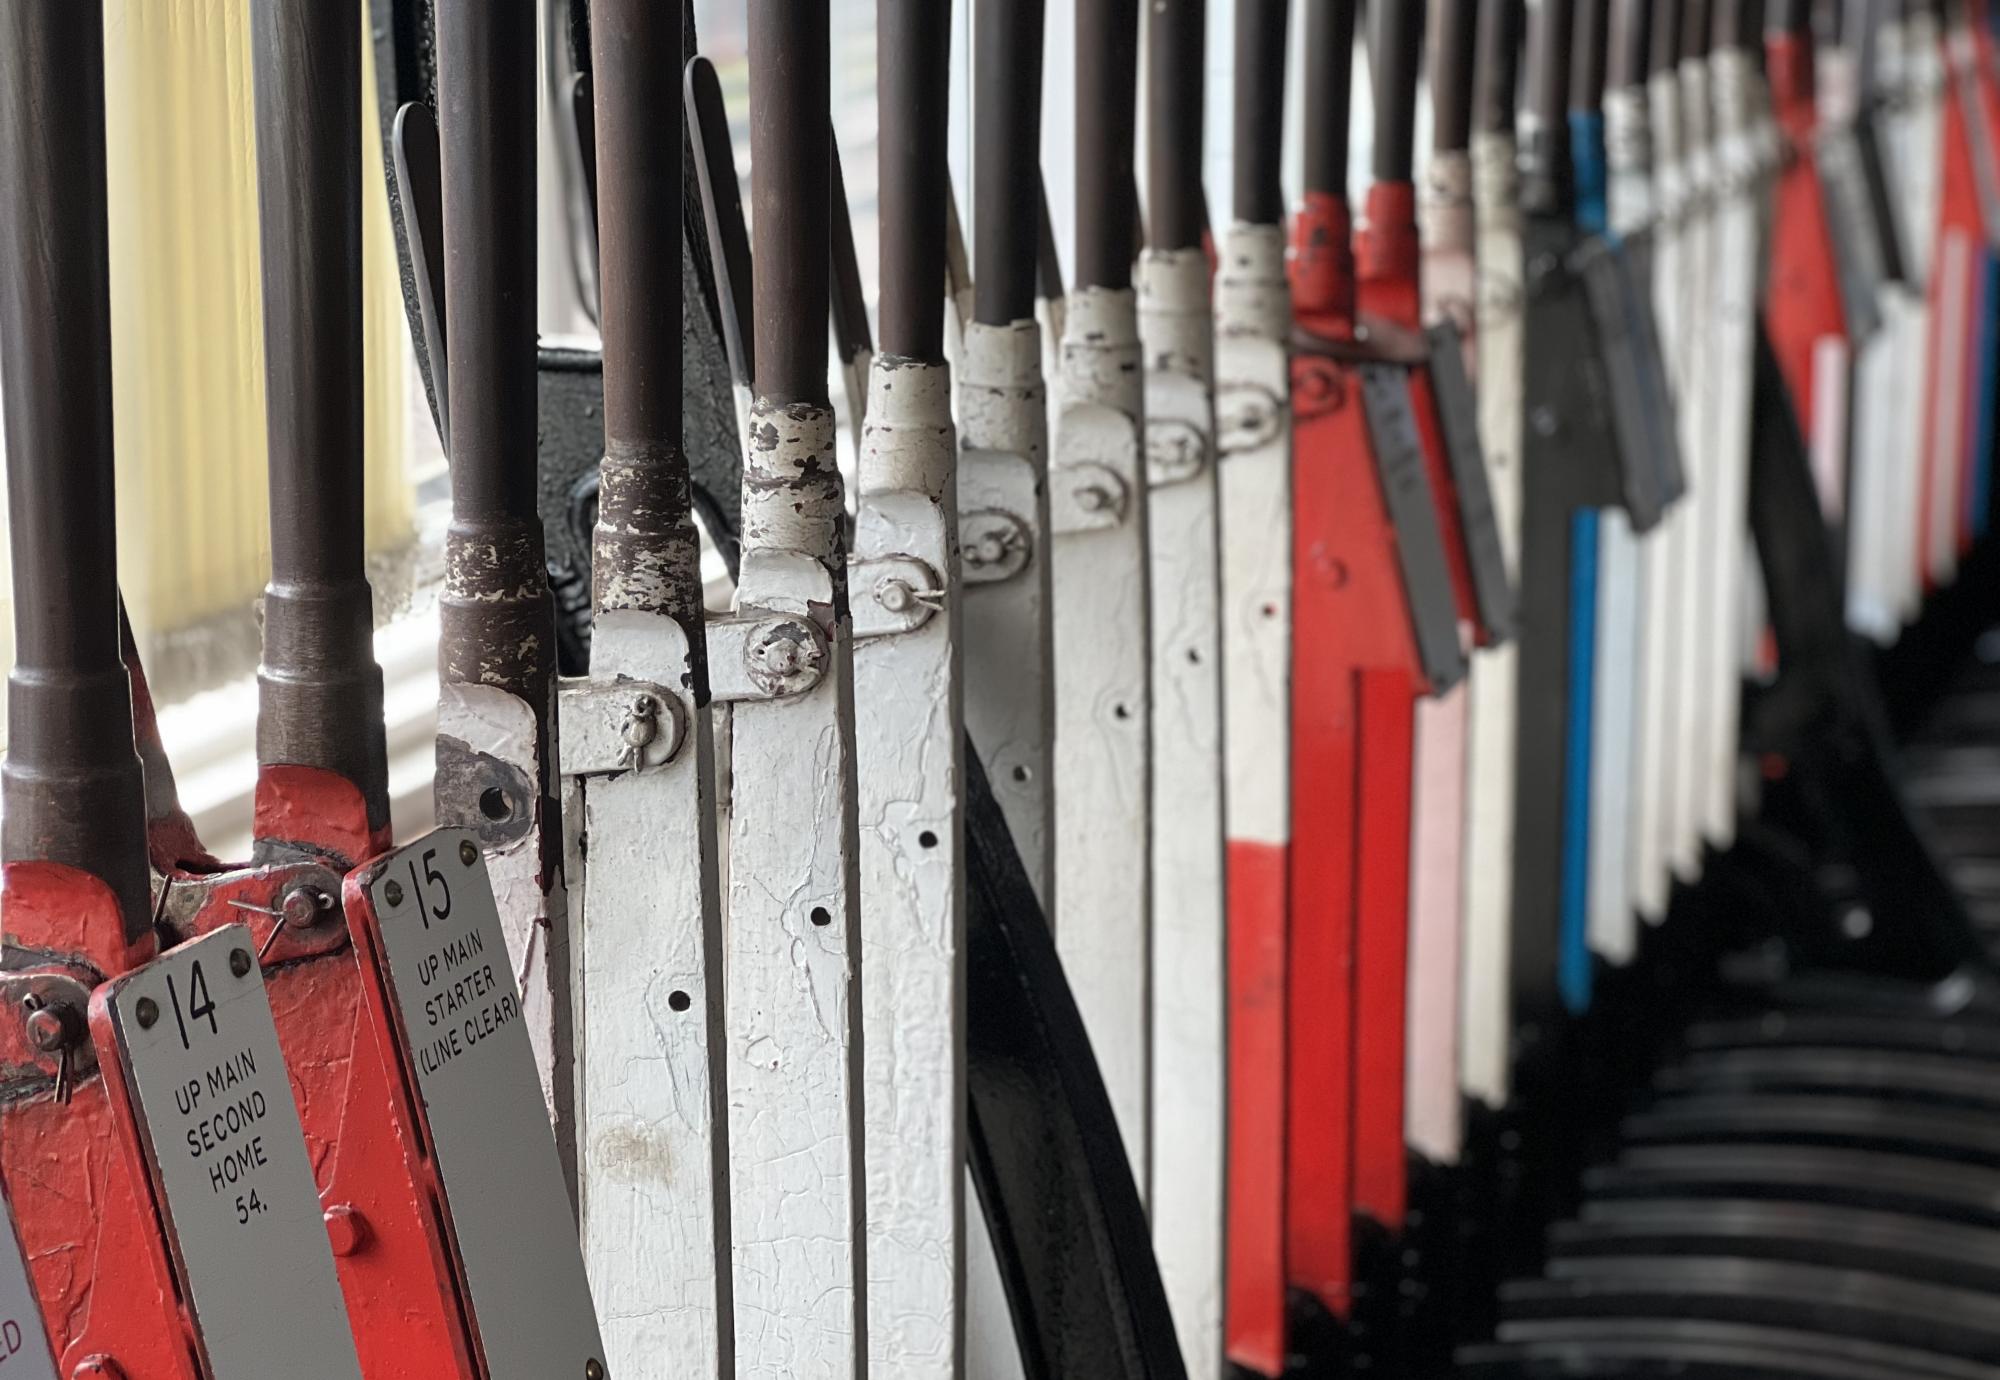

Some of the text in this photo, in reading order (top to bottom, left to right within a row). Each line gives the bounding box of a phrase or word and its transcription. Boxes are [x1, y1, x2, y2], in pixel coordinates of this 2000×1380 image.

[408, 848, 451, 930] 15
[417, 928, 484, 986] UP MAIN
[166, 960, 218, 1050] 14
[425, 964, 496, 1026] STARTER
[419, 991, 518, 1076] (LINE CLEAR)
[174, 1048, 257, 1115] UP MAIN
[187, 1090, 266, 1158] SECOND
[208, 1136, 268, 1193] HOME
[236, 1188, 268, 1225] 54.
